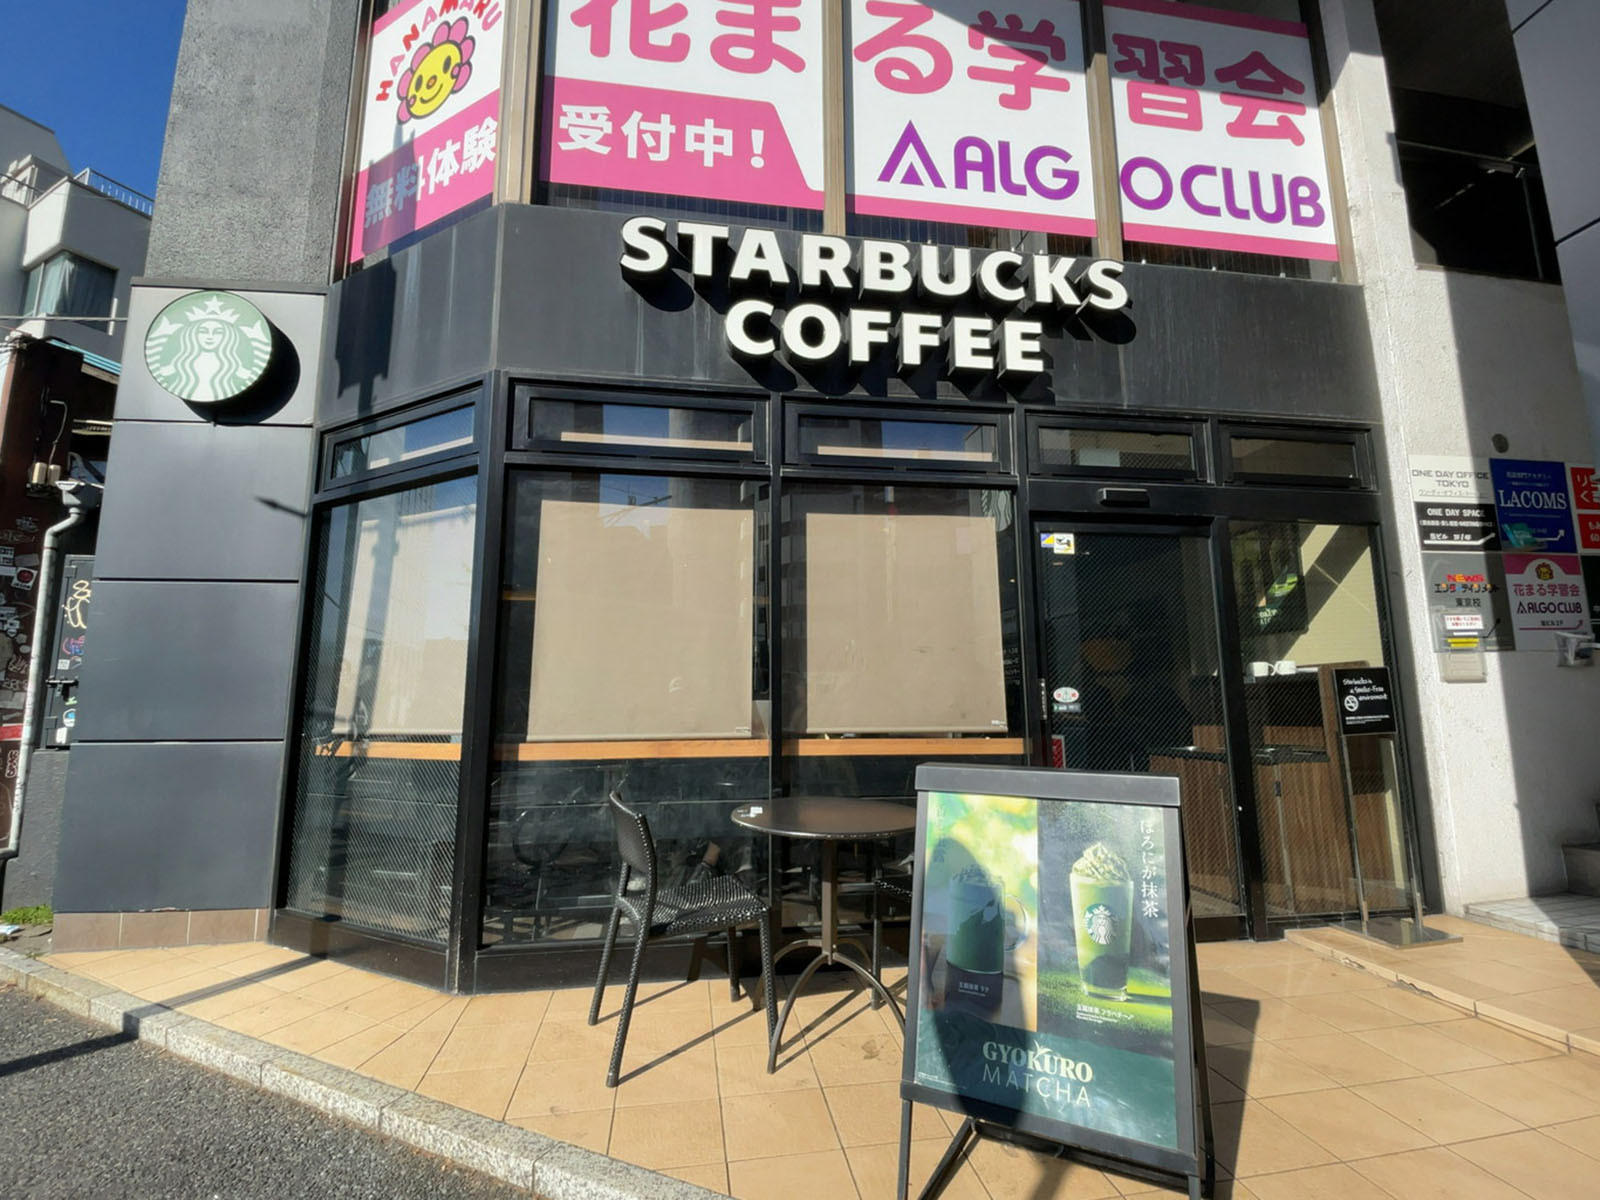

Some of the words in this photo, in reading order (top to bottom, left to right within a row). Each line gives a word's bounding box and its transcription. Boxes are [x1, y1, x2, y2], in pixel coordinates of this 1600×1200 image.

[365, 116, 498, 229] 無料体験
[620, 216, 1128, 311] STARBUCKS
[725, 300, 1044, 373] COFFEE
[1412, 469, 1433, 478] ONE
[1435, 470, 1455, 479] DAY
[1456, 471, 1490, 480] OFFICE
[1436, 480, 1470, 488] TOKYO
[1498, 489, 1568, 510] LACOMS
[1426, 508, 1443, 516] ONE
[1445, 508, 1460, 517] DAY
[1462, 509, 1486, 517] SPACE
[1446, 574, 1484, 582] NEWS
[1512, 583, 1579, 597] 花まる学習会
[982, 1040, 1093, 1083] GYOKURO
[982, 1063, 1091, 1108] MATCHA
